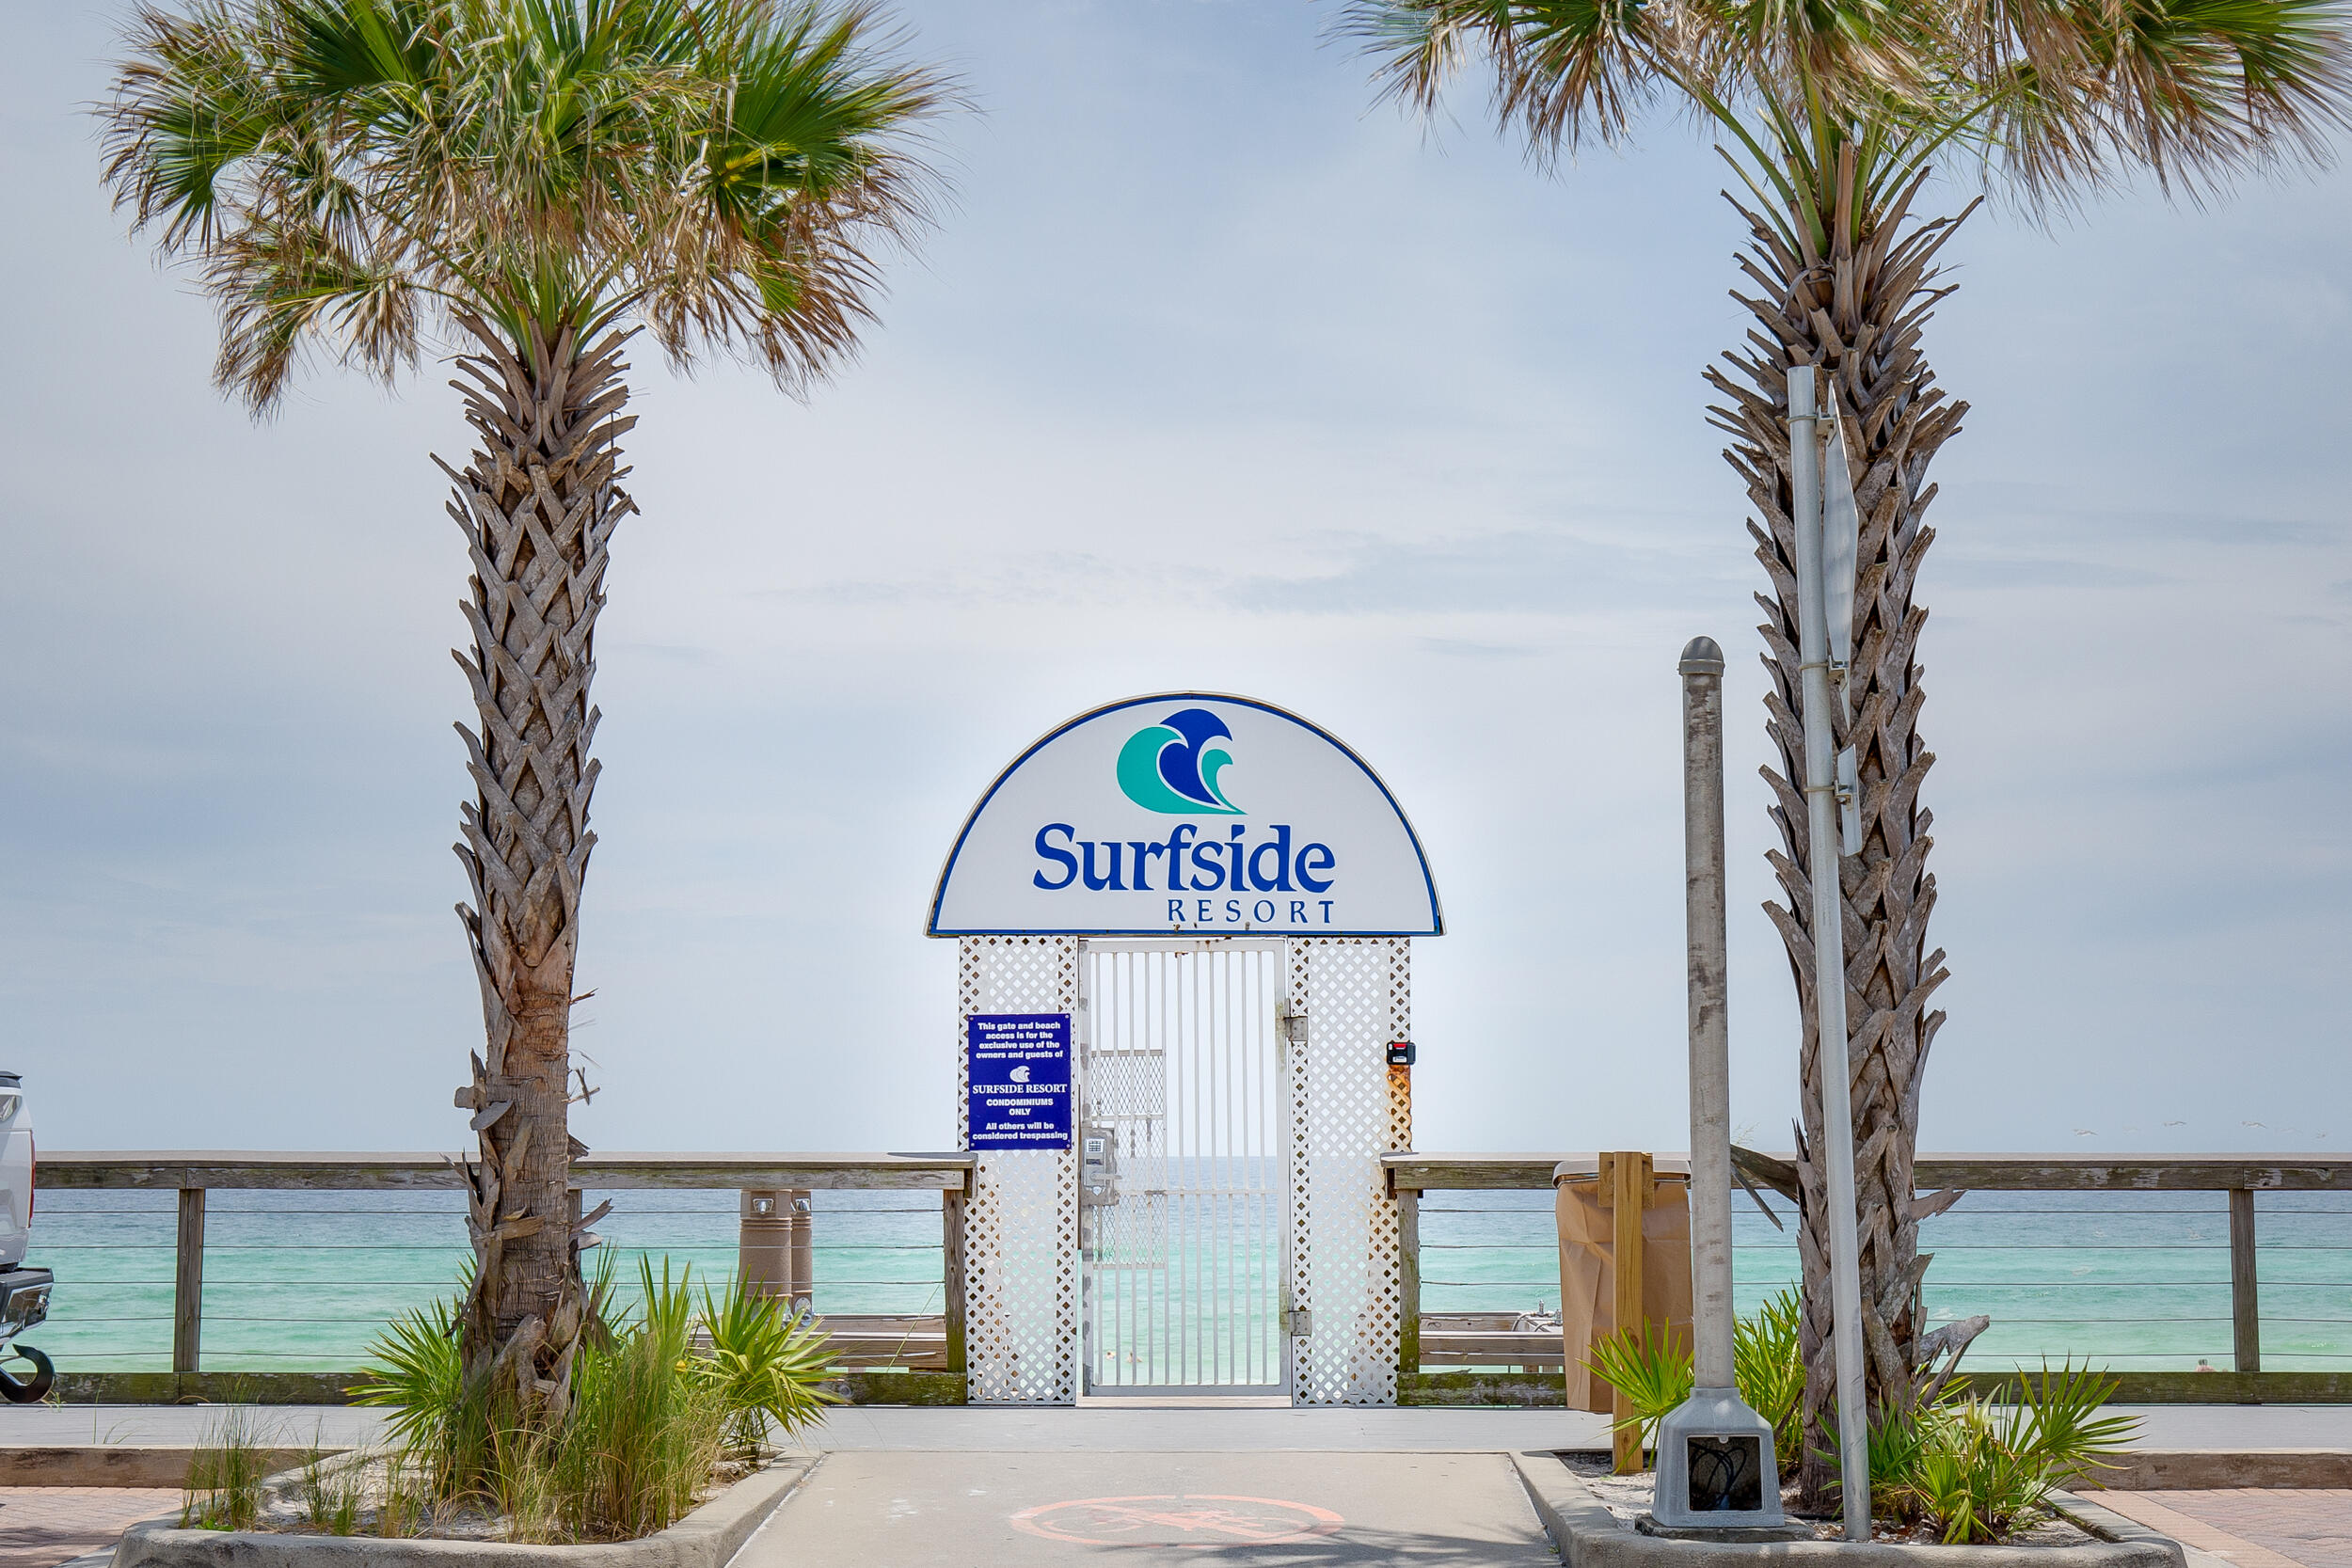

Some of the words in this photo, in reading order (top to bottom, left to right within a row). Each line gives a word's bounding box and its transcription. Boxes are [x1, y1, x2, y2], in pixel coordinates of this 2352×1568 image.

[1033, 823, 1336, 894] Surfside
[1167, 899, 1334, 924] RESORT
[997, 1022, 1016, 1031] gate
[1025, 1051, 1053, 1059] guests
[973, 1085, 1024, 1094] SURFSIDE
[1026, 1085, 1067, 1093] RESORT
[1020, 1132, 1068, 1140] trespassing
